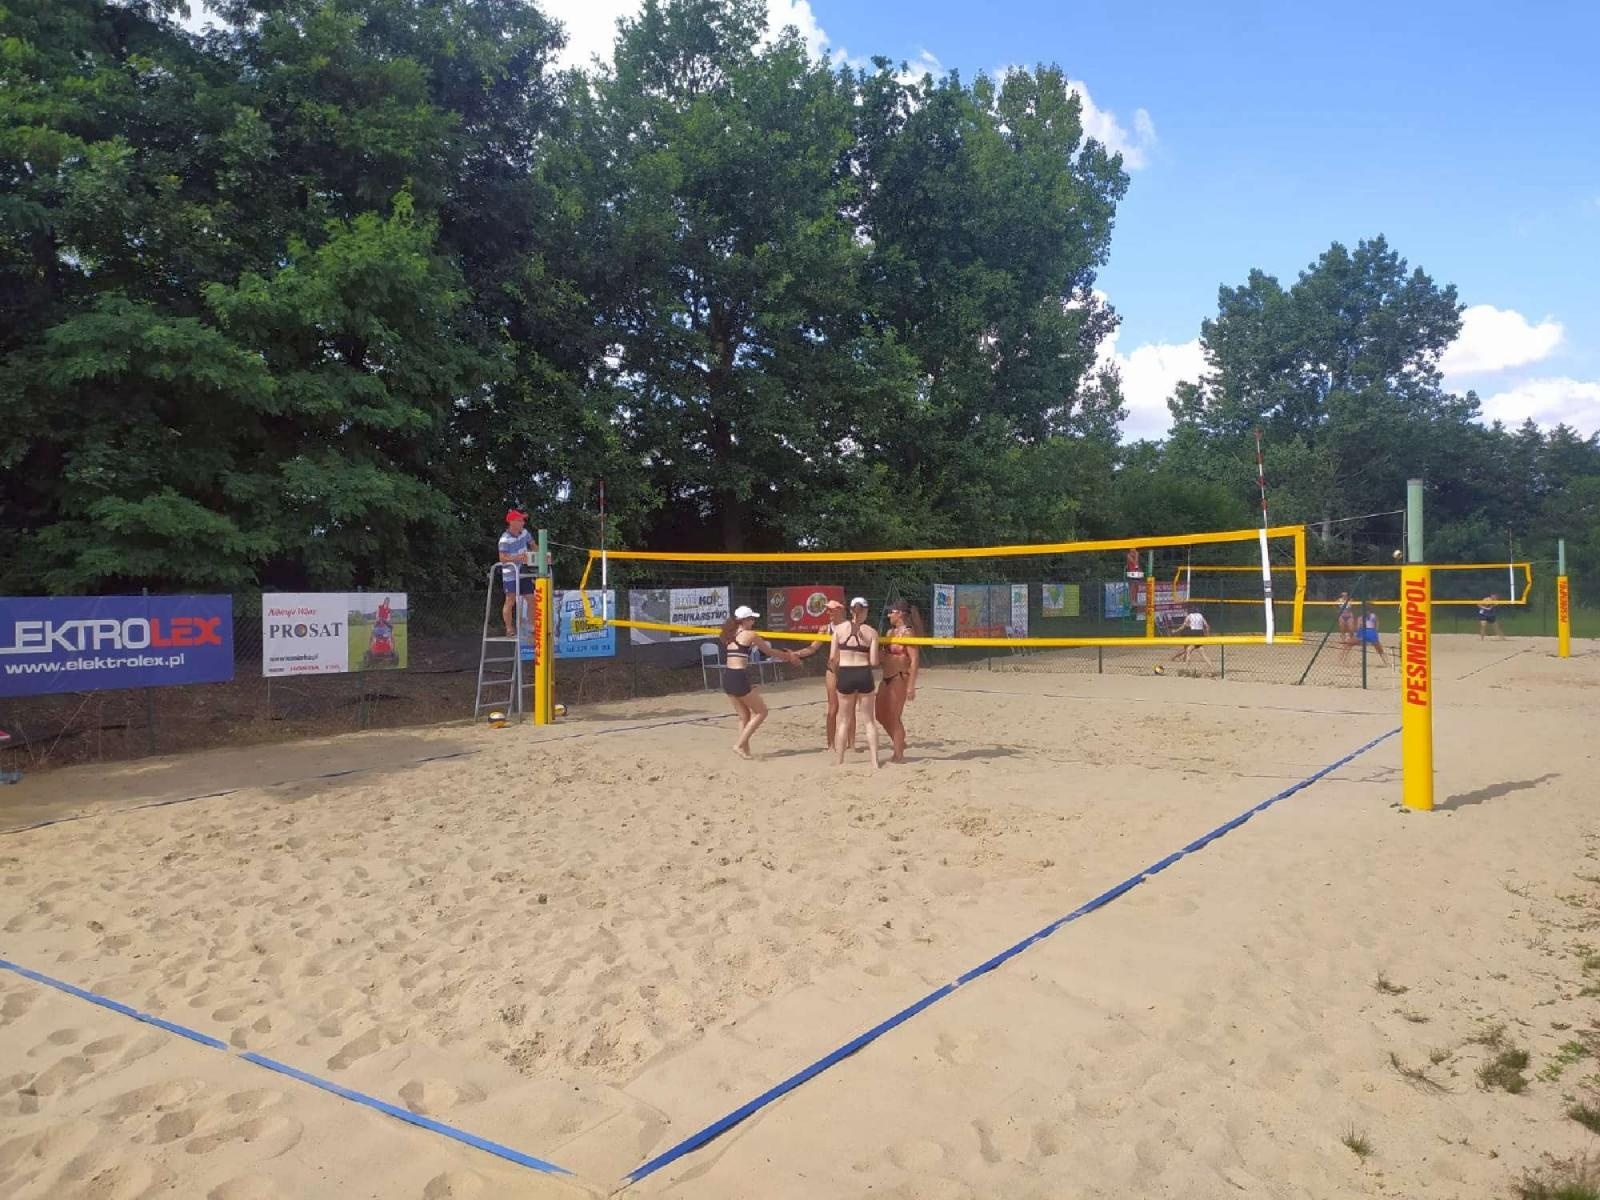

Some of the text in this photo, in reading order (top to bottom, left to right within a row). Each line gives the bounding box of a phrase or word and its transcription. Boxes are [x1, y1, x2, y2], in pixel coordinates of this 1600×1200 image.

[269, 623, 342, 638] PROSAT
[1406, 577, 1427, 706] PESMENPOL
[6, 653, 185, 674] www.elektrolex.pl
